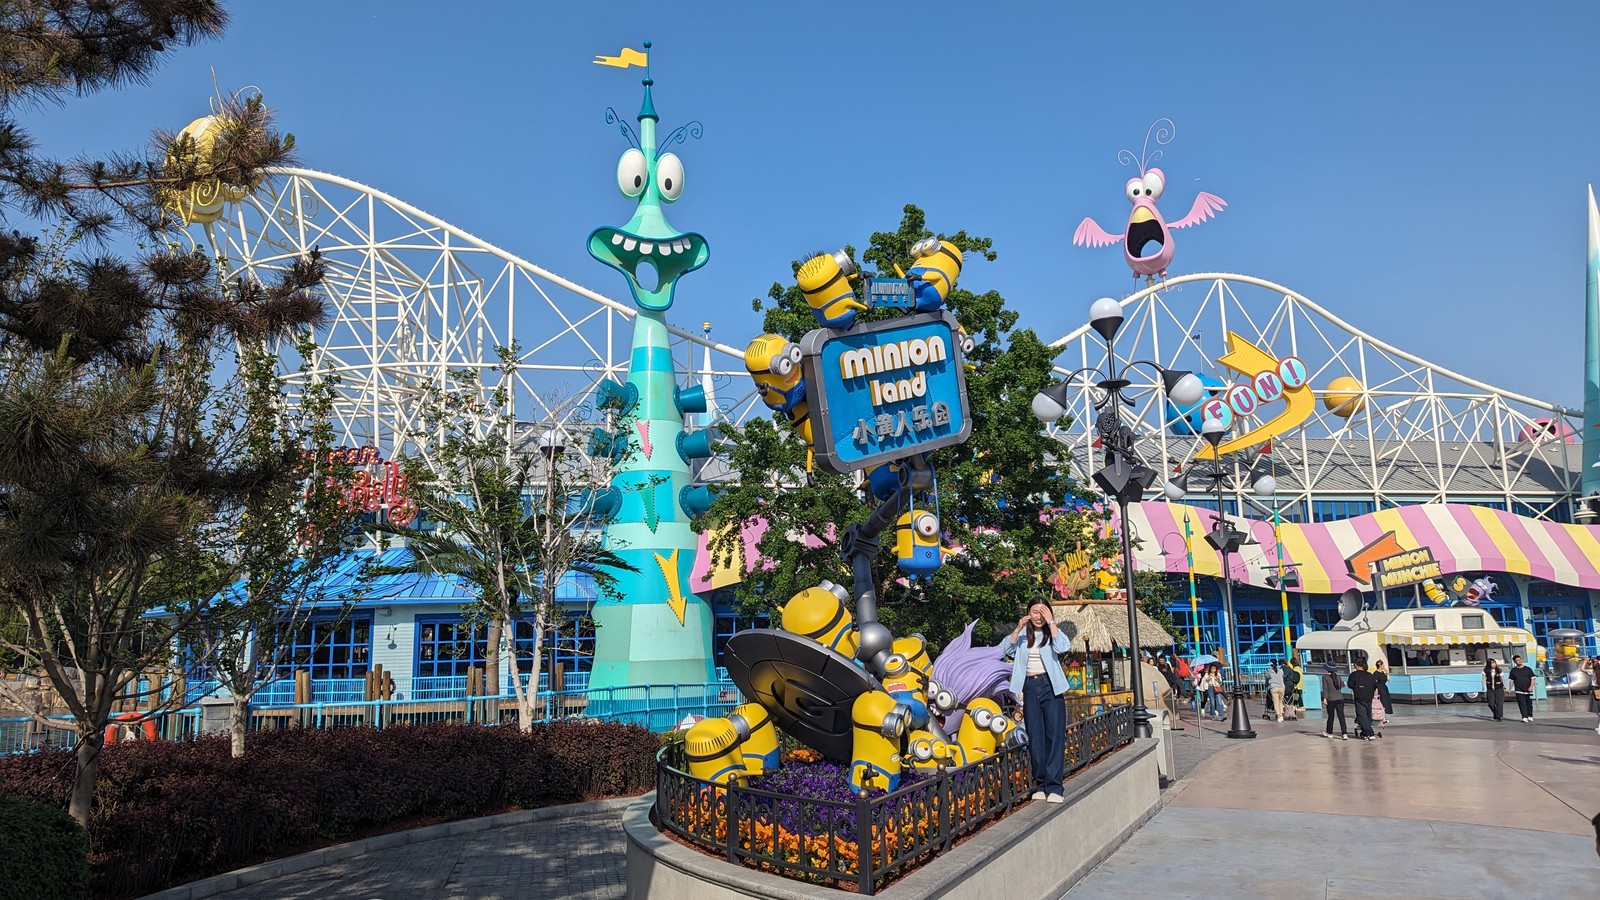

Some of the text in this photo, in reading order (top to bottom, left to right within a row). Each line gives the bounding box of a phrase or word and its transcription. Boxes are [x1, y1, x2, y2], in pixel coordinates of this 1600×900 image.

[869, 371, 927, 407] land
[1207, 360, 1300, 419] FUN!
[852, 401, 949, 445] 小黄人乐园
[1383, 549, 1431, 571] MINION
